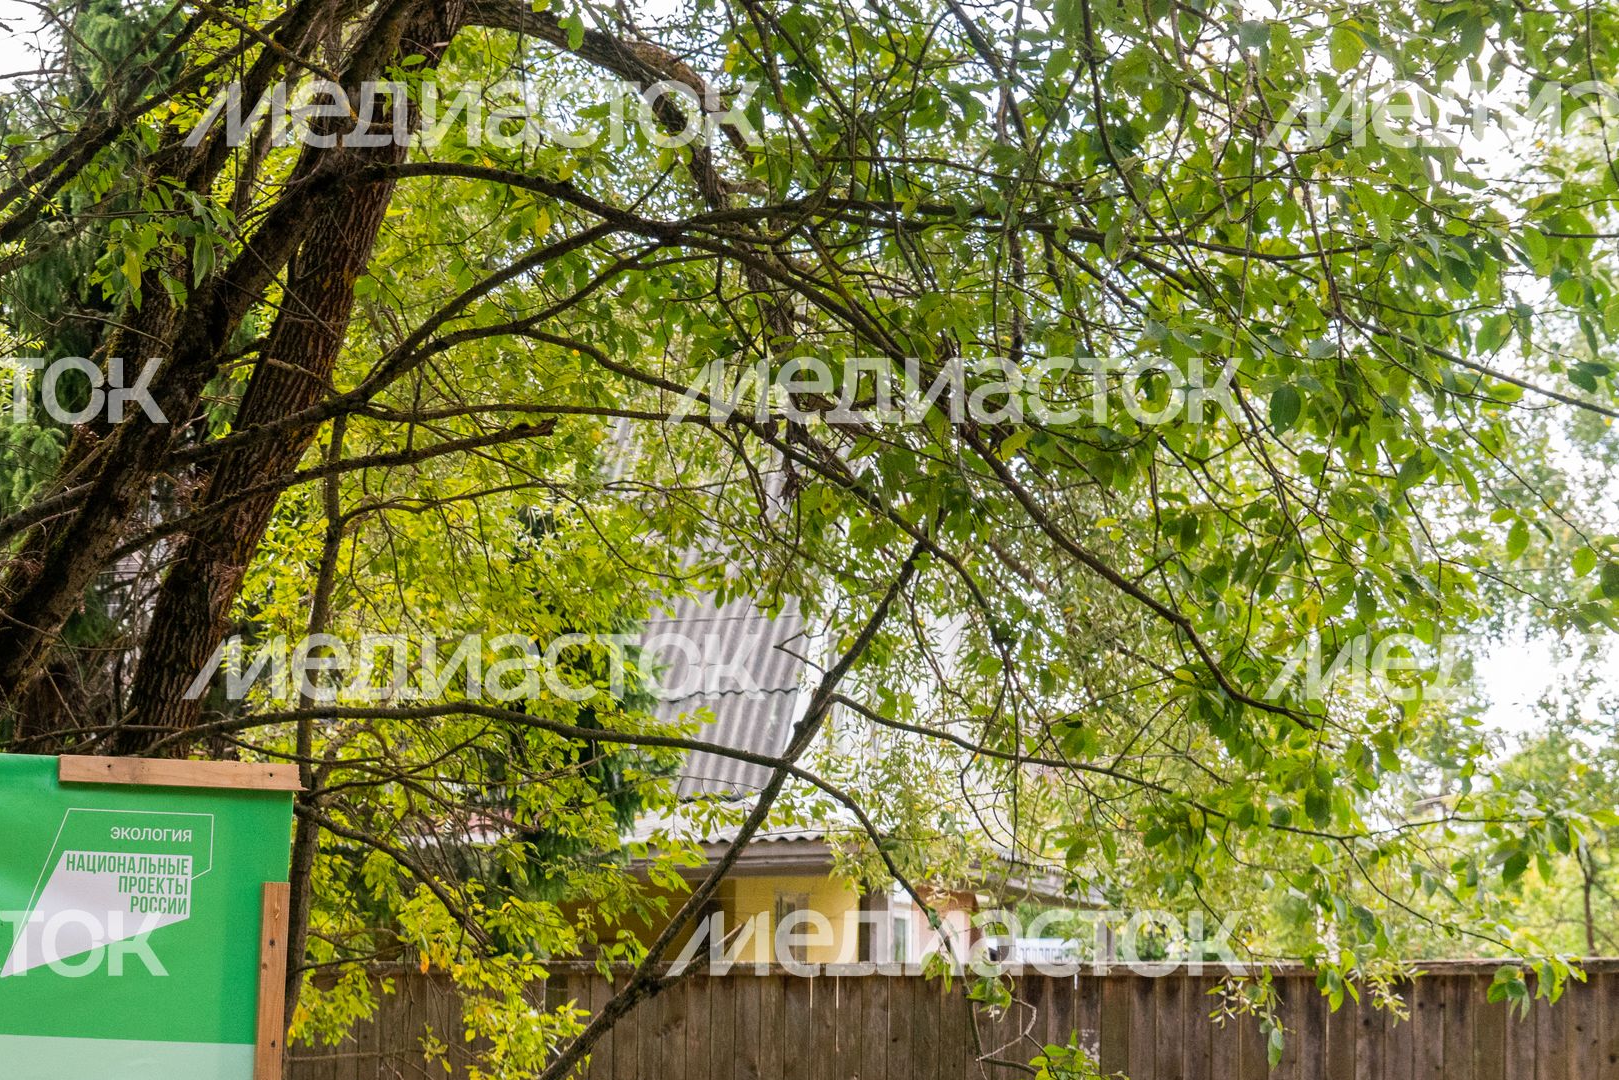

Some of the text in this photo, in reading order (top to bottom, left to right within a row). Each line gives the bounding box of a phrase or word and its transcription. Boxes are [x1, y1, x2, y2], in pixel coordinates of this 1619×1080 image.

[66, 854, 189, 875] НАЦИОНАЛЬНЫЕ
[119, 876, 187, 895] ПРОЕКТЫ
[130, 896, 187, 915] РОССИИ
